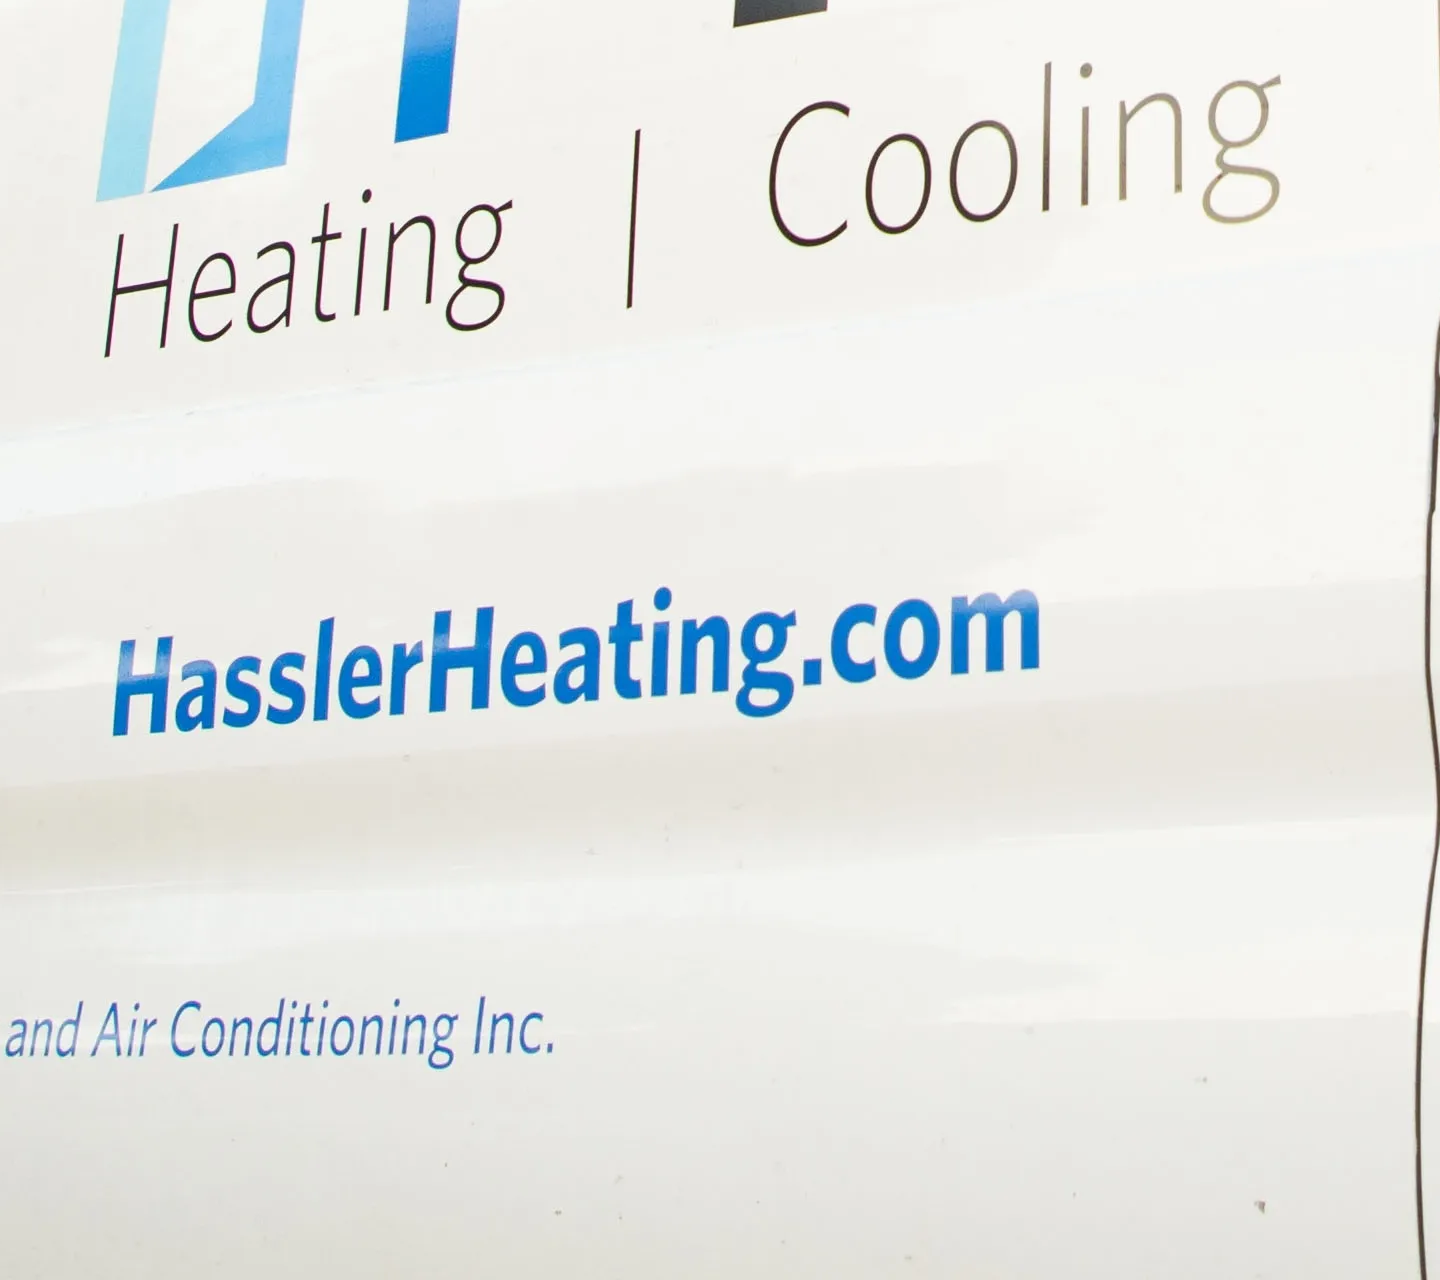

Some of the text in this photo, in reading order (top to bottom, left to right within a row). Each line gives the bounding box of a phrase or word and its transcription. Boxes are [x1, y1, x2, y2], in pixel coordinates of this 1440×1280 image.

[103, 187, 513, 359] Heating
[768, 61, 1282, 250] Cooling
[112, 586, 1041, 738] HasslerHeating.com
[4, 1000, 84, 1059] and
[90, 1000, 158, 1058] Air
[169, 997, 460, 1071] Conditioning
[473, 995, 554, 1055] Inc.
